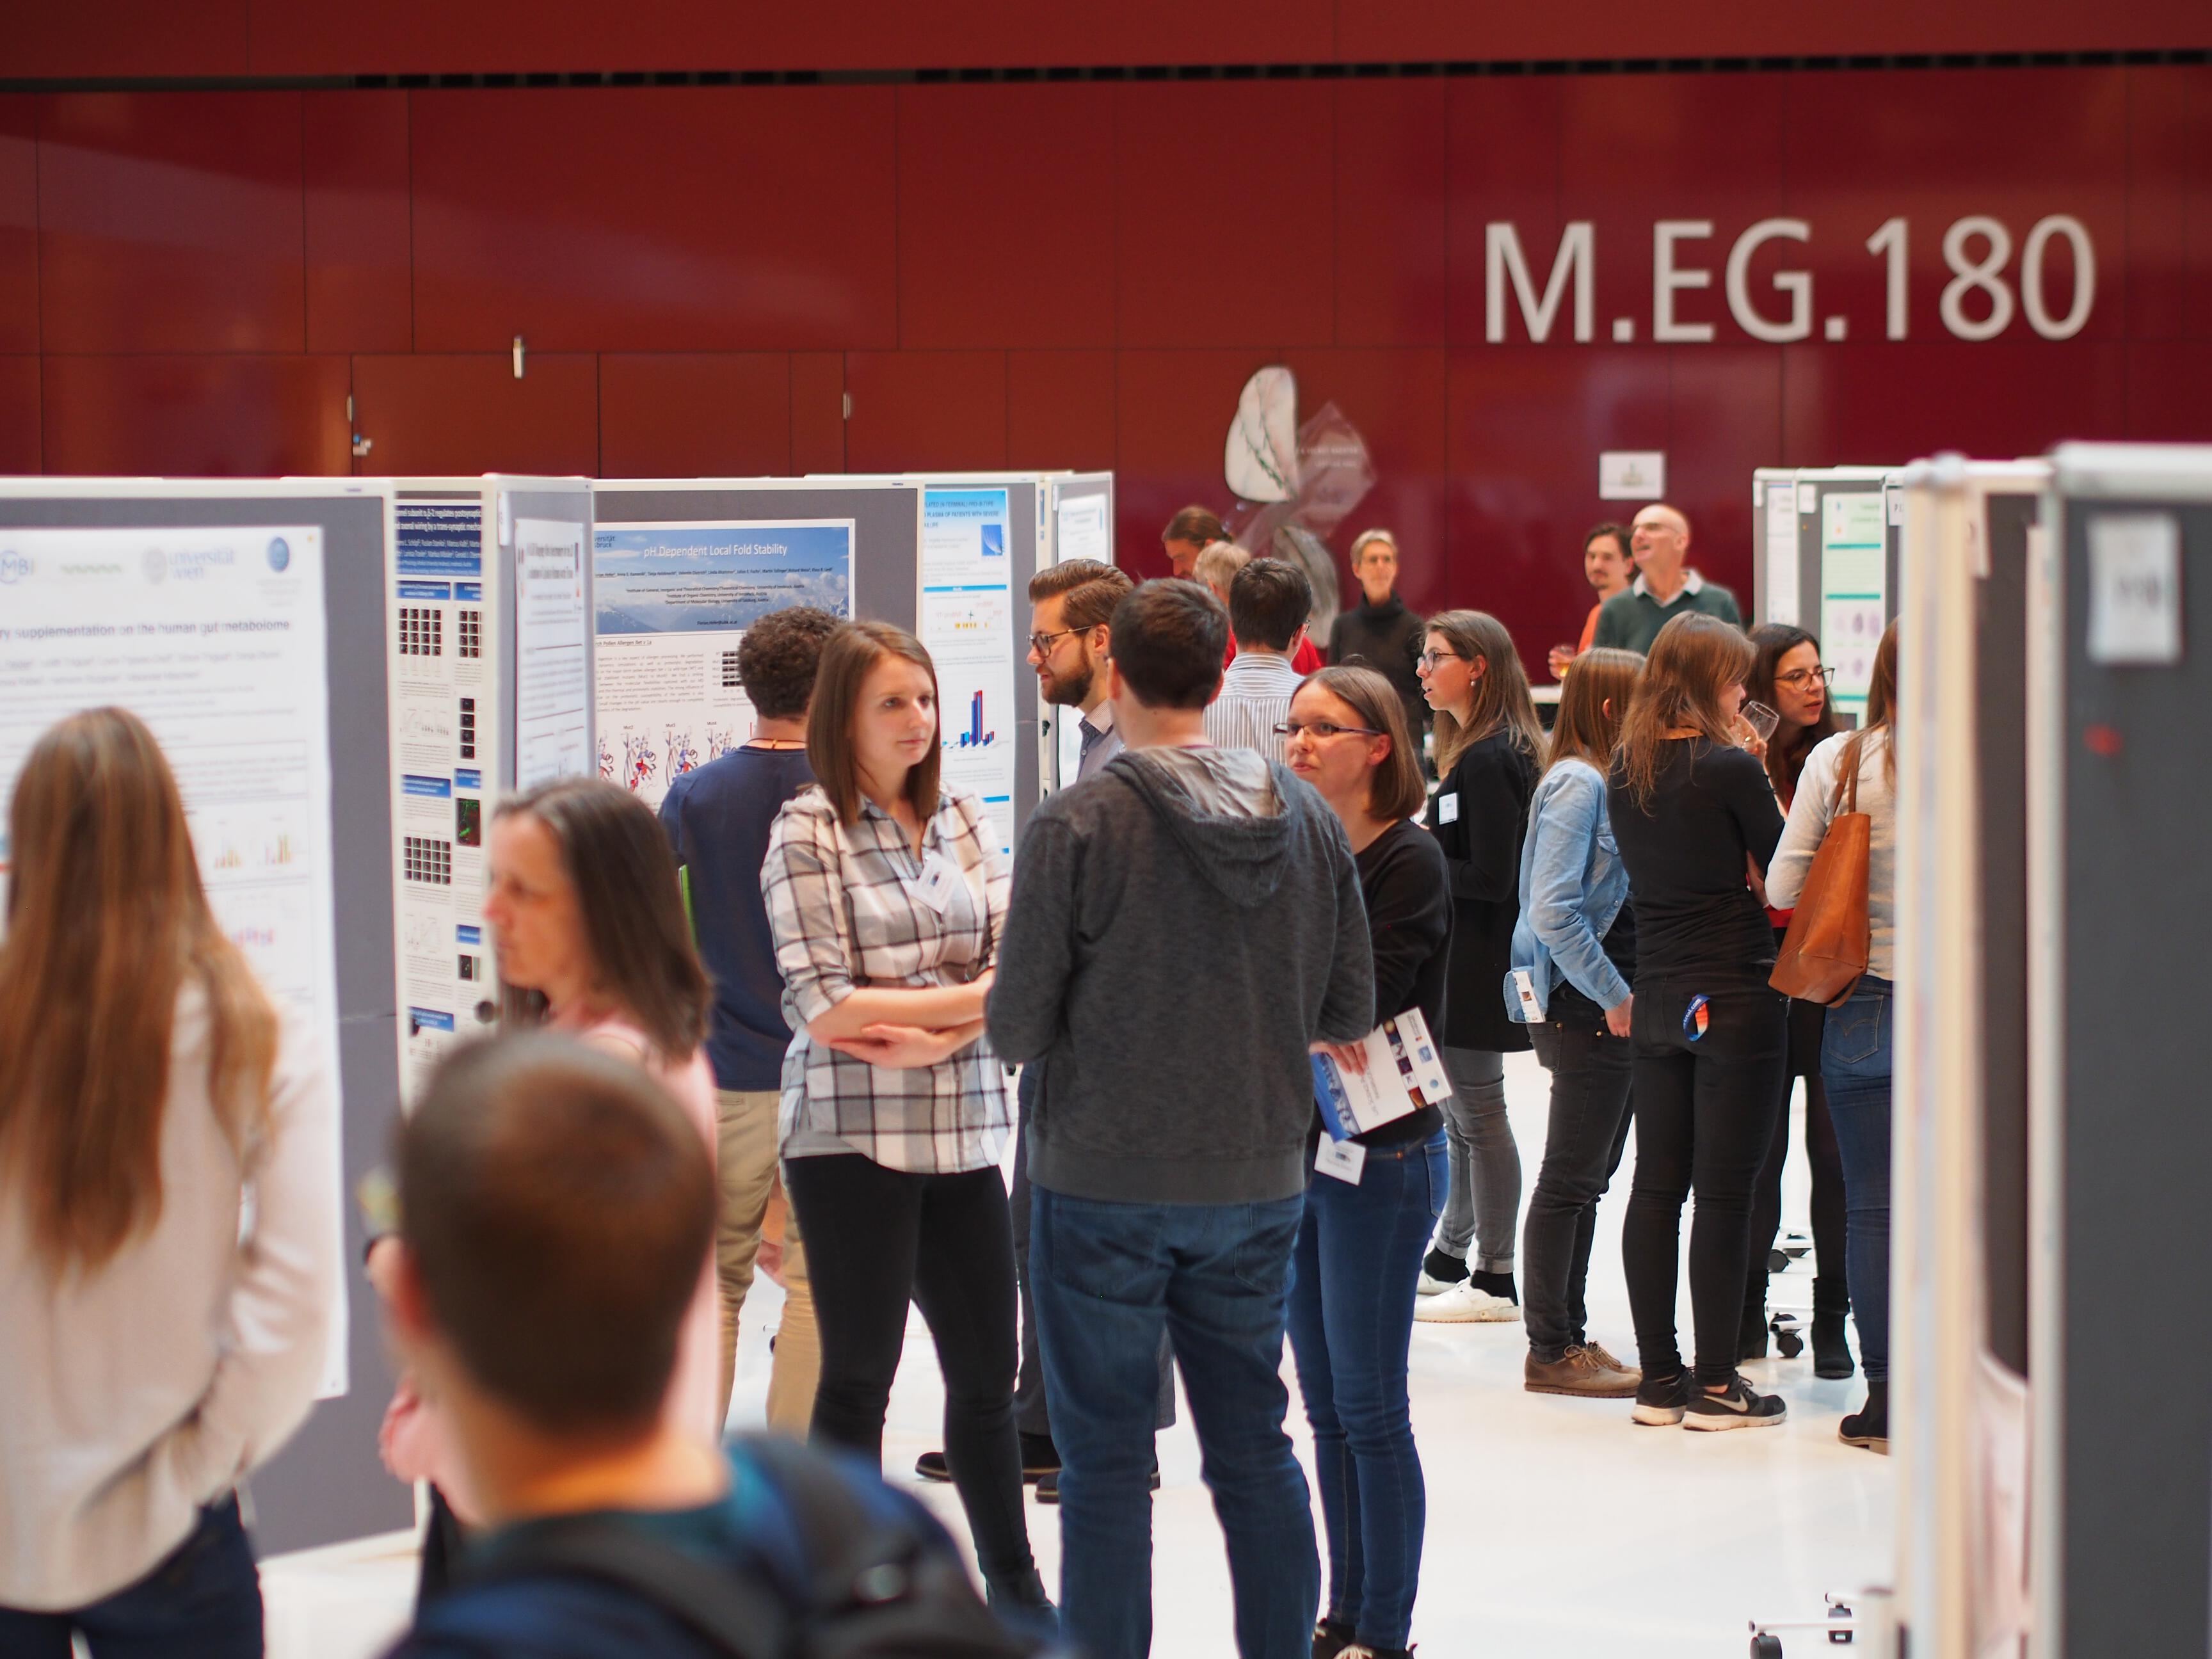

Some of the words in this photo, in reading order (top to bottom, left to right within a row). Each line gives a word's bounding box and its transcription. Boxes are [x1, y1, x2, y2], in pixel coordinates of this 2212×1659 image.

[1484, 214, 2097, 344] M.EG.180
[644, 547, 656, 559] pH
[659, 545, 707, 559] Dependent
[710, 544, 731, 556] Local
[733, 543, 751, 556] Fold
[753, 543, 787, 557] Stability
[15, 624, 115, 639] supplementation
[119, 625, 134, 636] on
[138, 622, 155, 635] the
[158, 621, 196, 634] human
[200, 621, 218, 636] gut
[221, 618, 291, 632] metabolome
